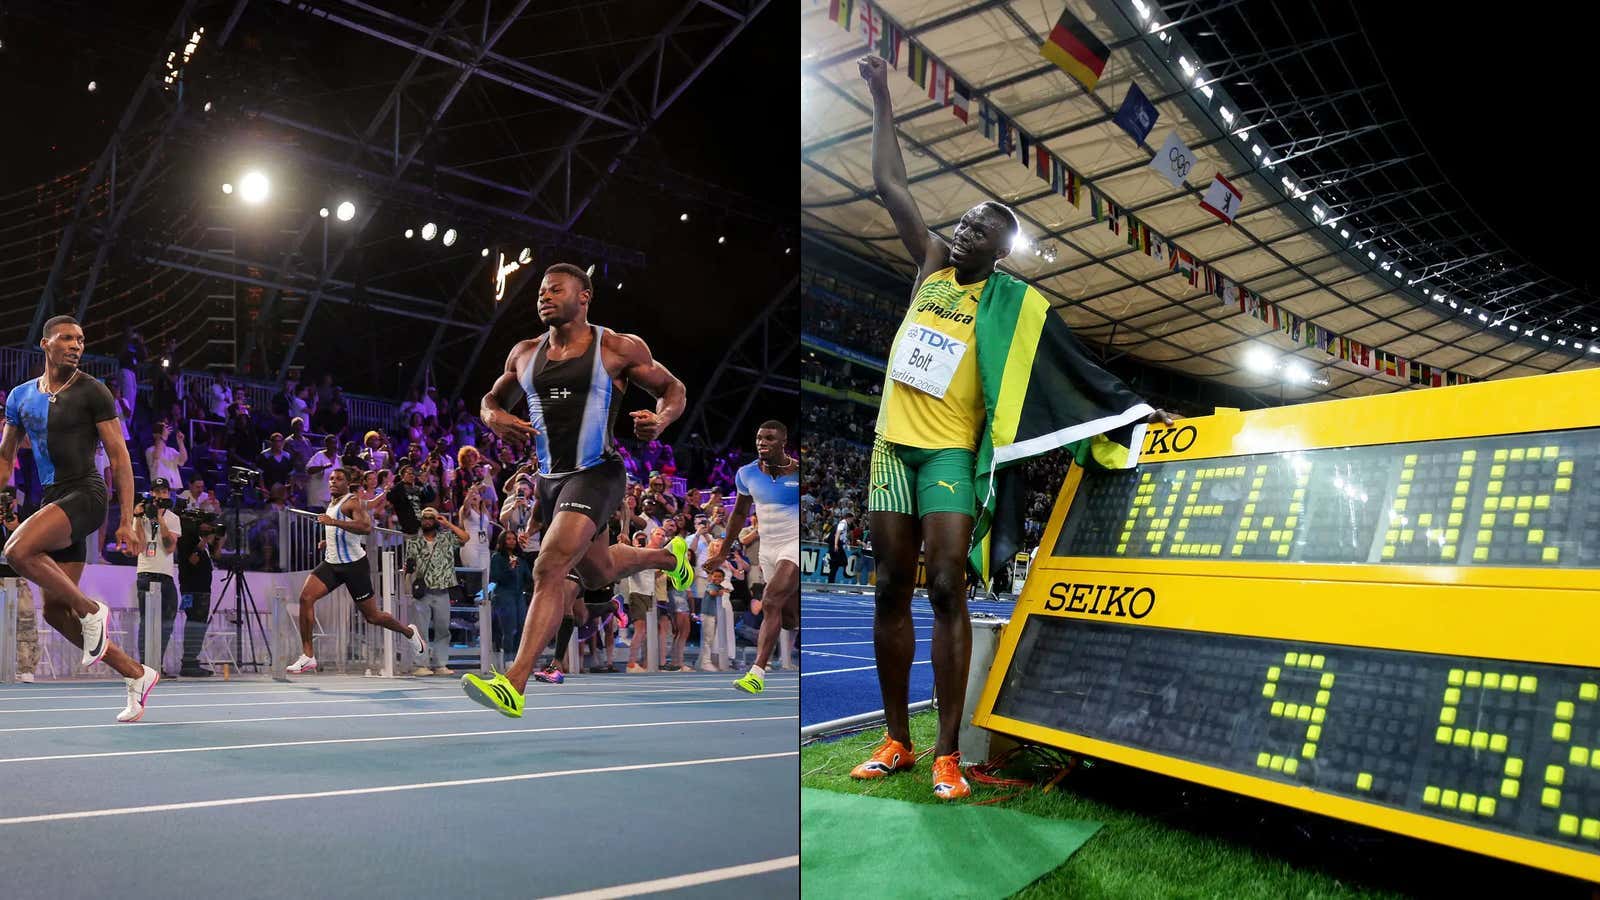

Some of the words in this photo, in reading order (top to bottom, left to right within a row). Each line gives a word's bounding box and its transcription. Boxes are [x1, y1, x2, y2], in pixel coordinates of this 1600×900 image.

[919, 327, 960, 356] TDK
[908, 347, 933, 372] Bolt
[1116, 461, 1312, 558] NEW
[1381, 446, 1575, 563] WR
[1044, 582, 1156, 619] SEIKO
